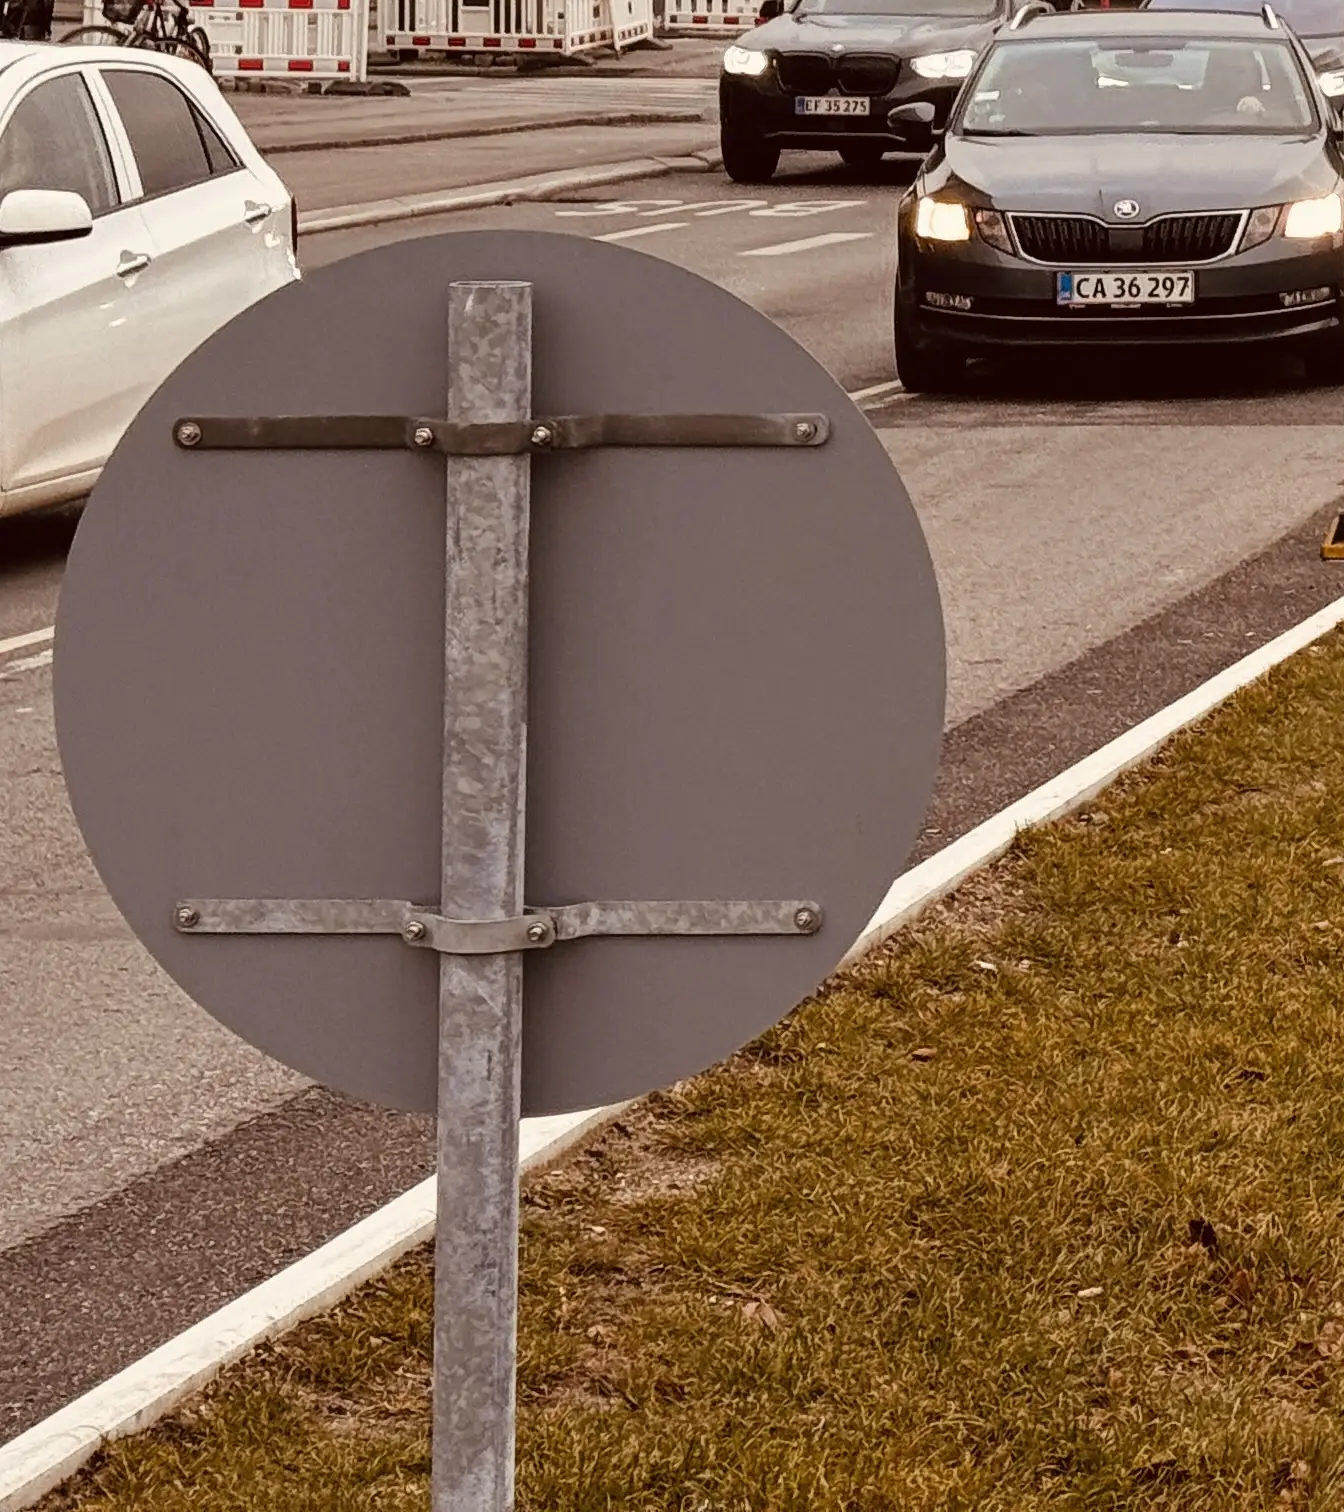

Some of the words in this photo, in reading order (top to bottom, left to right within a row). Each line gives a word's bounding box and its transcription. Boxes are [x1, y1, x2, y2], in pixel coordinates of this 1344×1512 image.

[1076, 278, 1107, 299] CA
[1113, 276, 1141, 299] 36
[1147, 276, 1190, 299] 297
